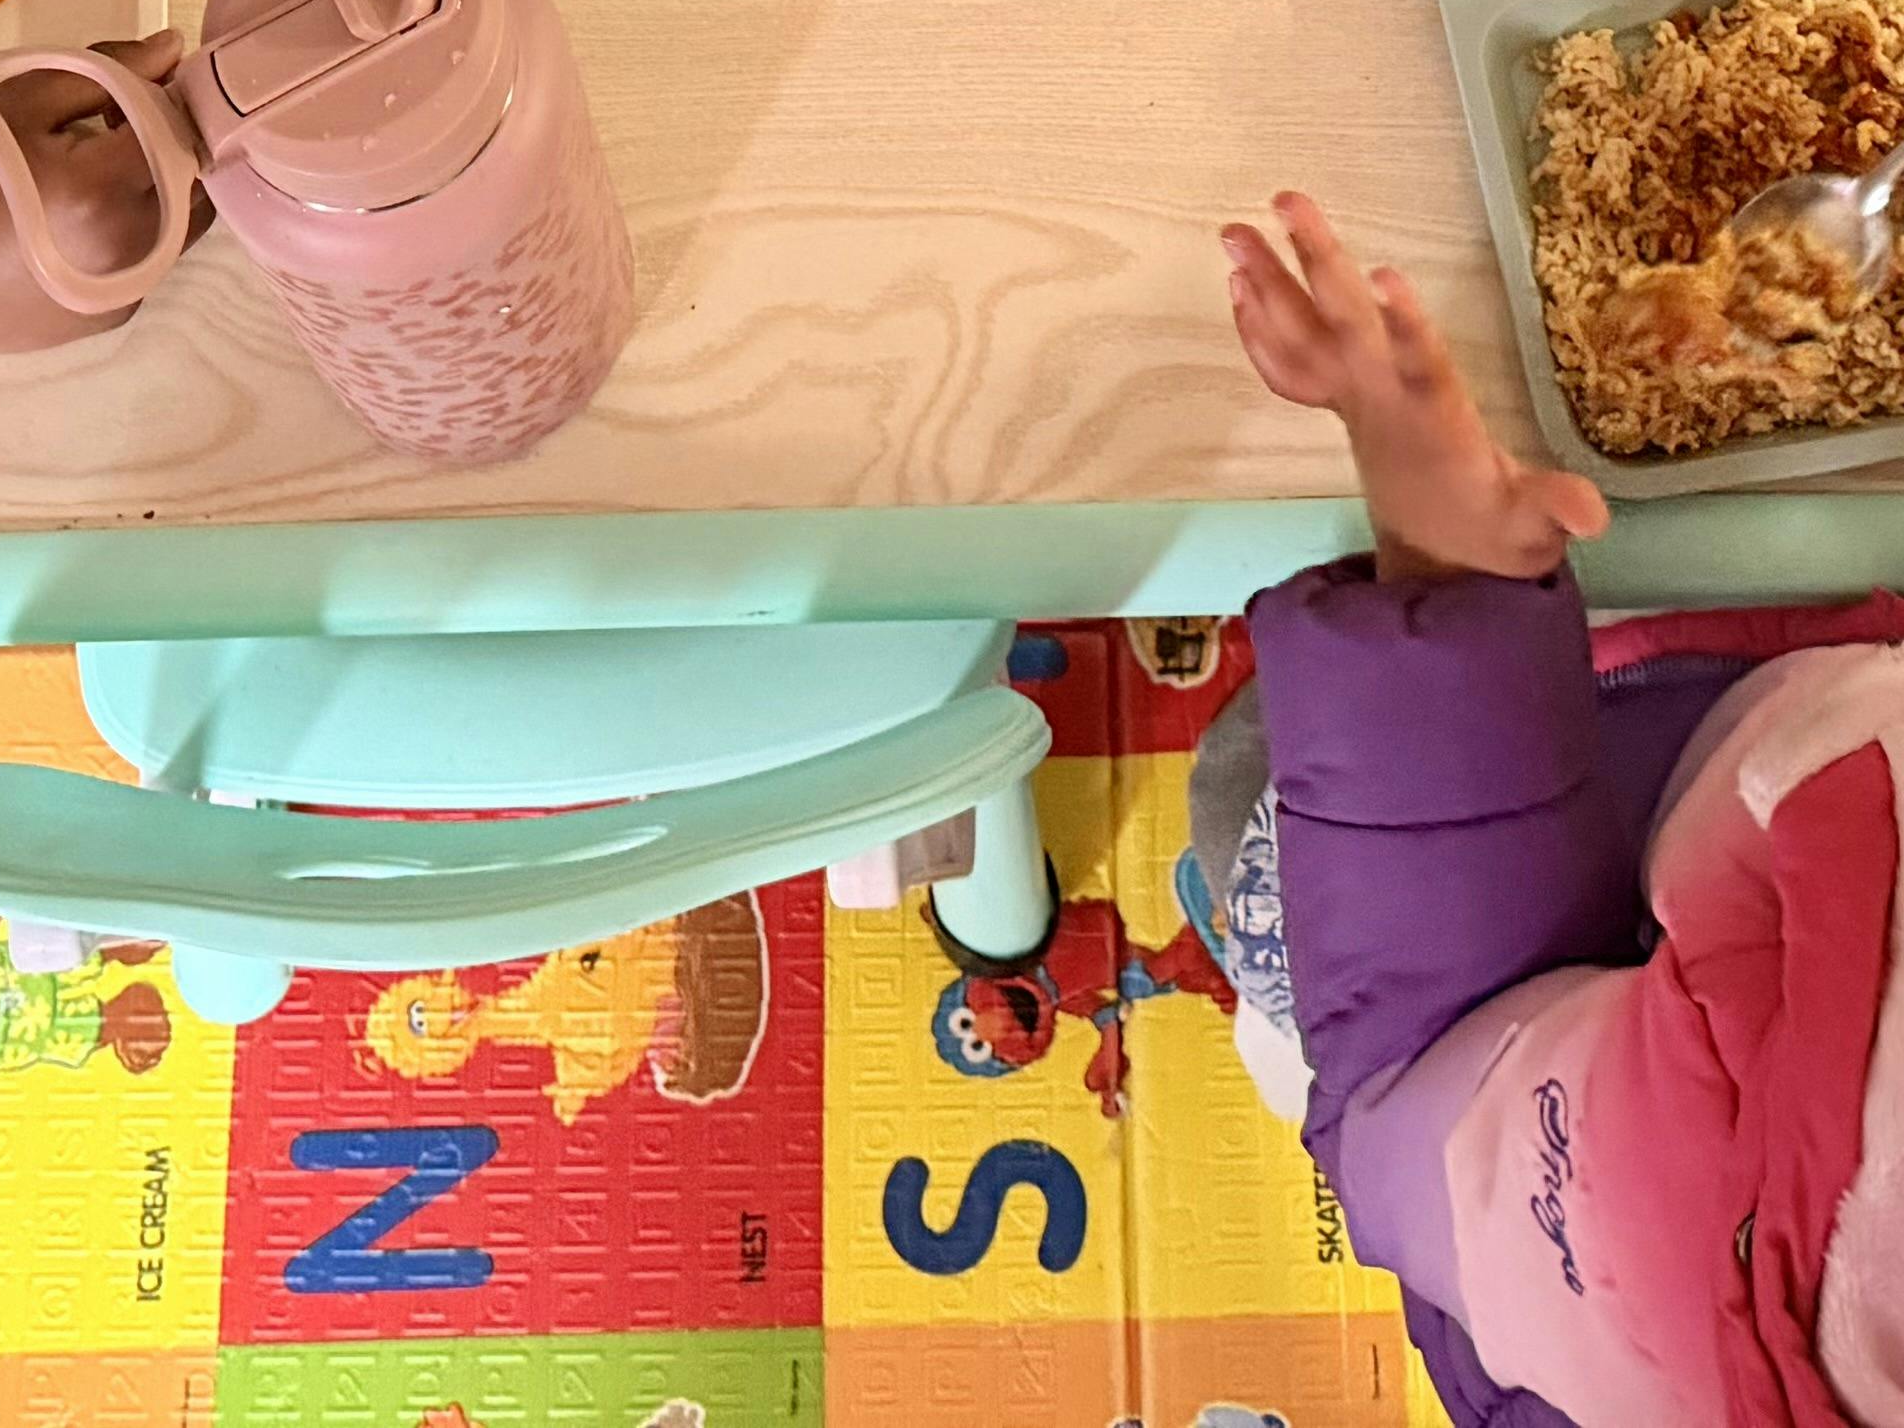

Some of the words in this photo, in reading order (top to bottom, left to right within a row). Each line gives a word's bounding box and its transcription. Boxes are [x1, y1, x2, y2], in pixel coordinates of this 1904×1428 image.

[139, 1146, 172, 1249] CREAM
[284, 1125, 501, 1293] N
[742, 1210, 768, 1283] NEST
[883, 1139, 1088, 1276] S
[136, 1257, 165, 1302] ICE
